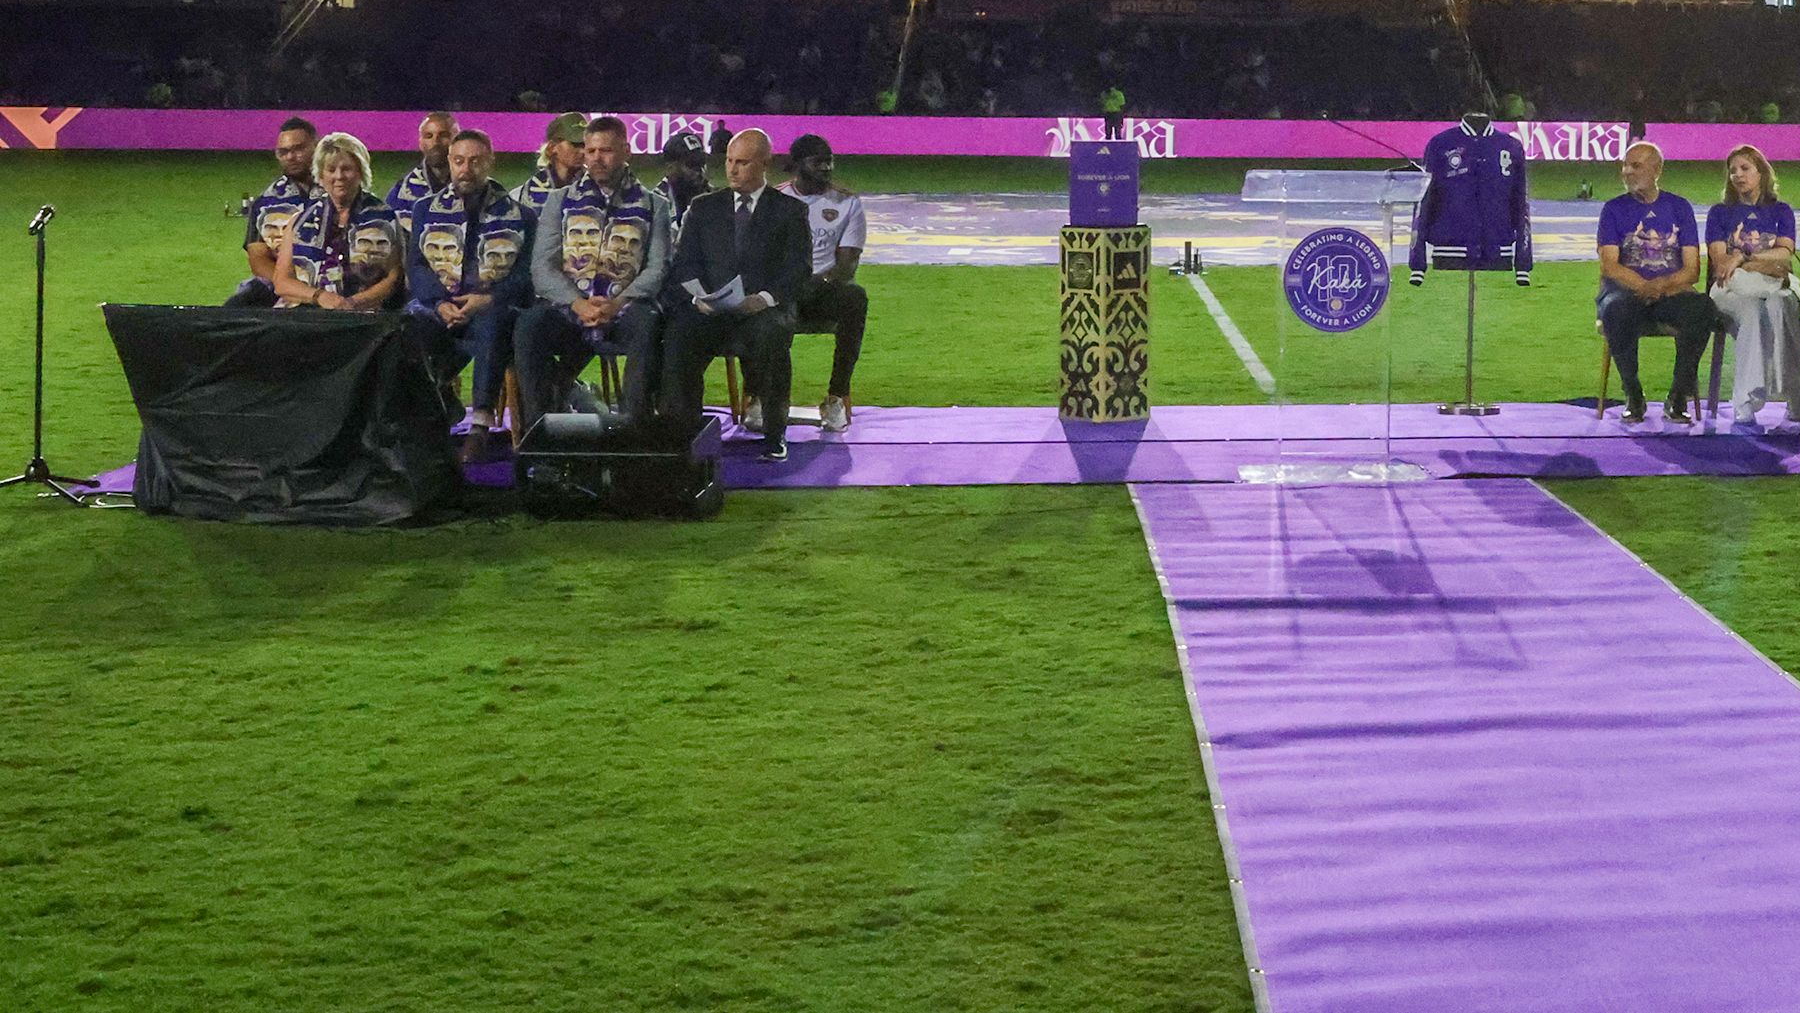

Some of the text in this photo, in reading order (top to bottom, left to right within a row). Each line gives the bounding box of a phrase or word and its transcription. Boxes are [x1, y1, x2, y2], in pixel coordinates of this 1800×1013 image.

[1292, 233, 1344, 270] CELEBRATING
[1356, 240, 1381, 270] LEGEND
[1301, 304, 1340, 326] FOREVER
[1352, 304, 1373, 322] LION
